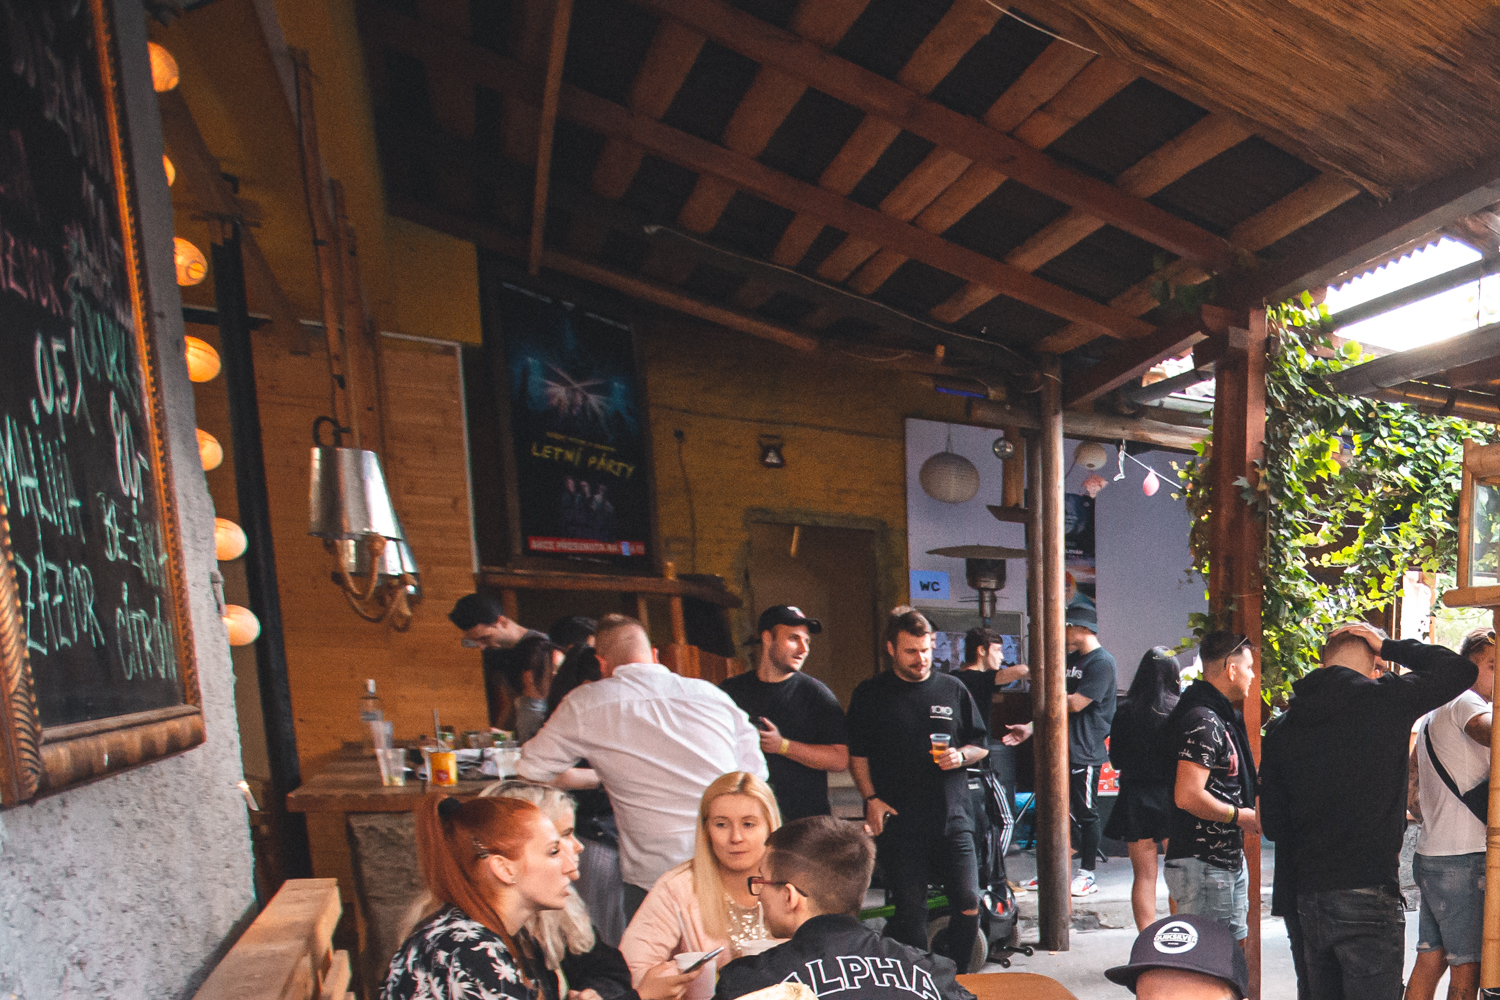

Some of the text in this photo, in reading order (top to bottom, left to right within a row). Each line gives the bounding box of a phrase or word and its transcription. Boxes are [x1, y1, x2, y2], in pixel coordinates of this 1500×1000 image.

[531, 442, 635, 479] LETNÍ PÁRTY
[919, 580, 940, 592] WC
